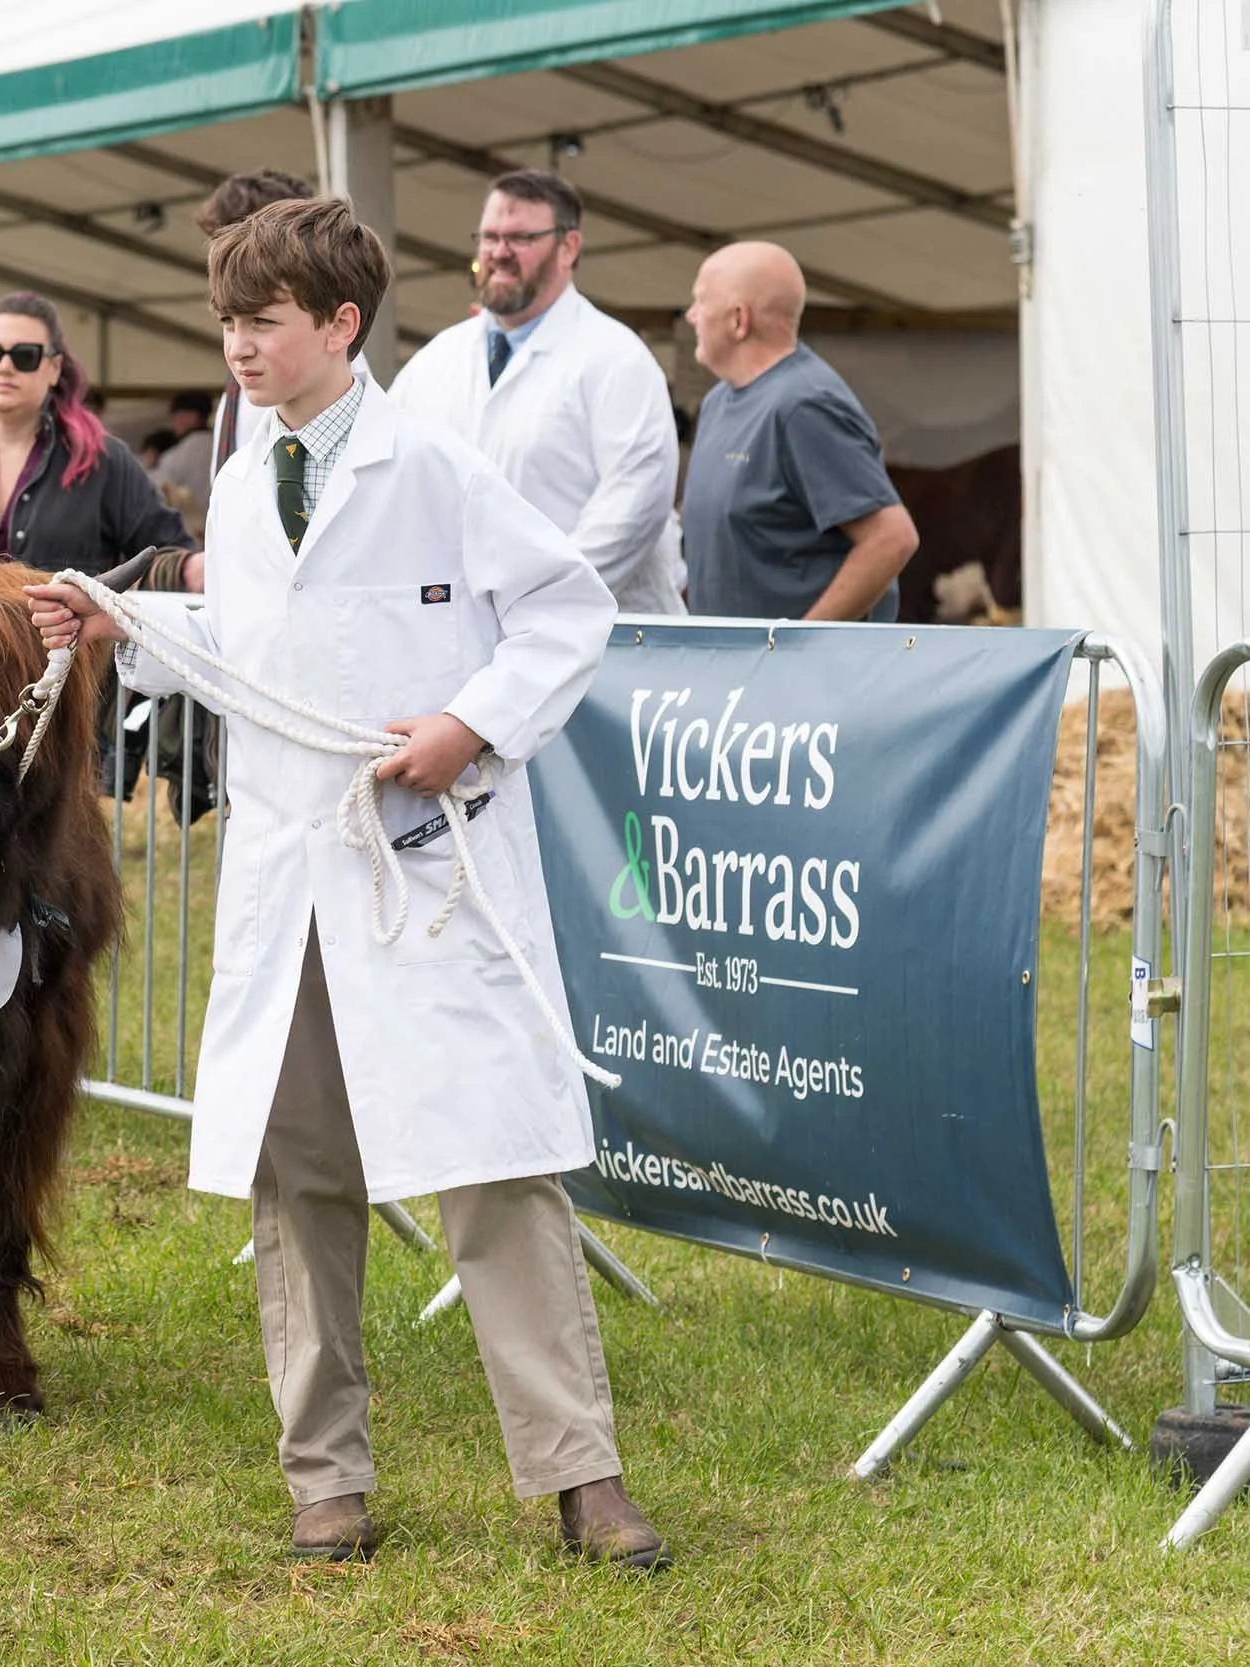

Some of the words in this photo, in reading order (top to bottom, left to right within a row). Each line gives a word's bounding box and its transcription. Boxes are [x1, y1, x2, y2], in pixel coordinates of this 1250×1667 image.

[630, 687, 839, 810] Vickers
[696, 951, 722, 989] Est.
[724, 956, 758, 995] 1973
[592, 1013, 647, 1061] Land
[651, 1028, 699, 1070] and
[700, 1032, 770, 1083] Estate
[774, 1045, 864, 1101] Agents
[595, 1137, 898, 1238] vickersandbarrass.co.uk
